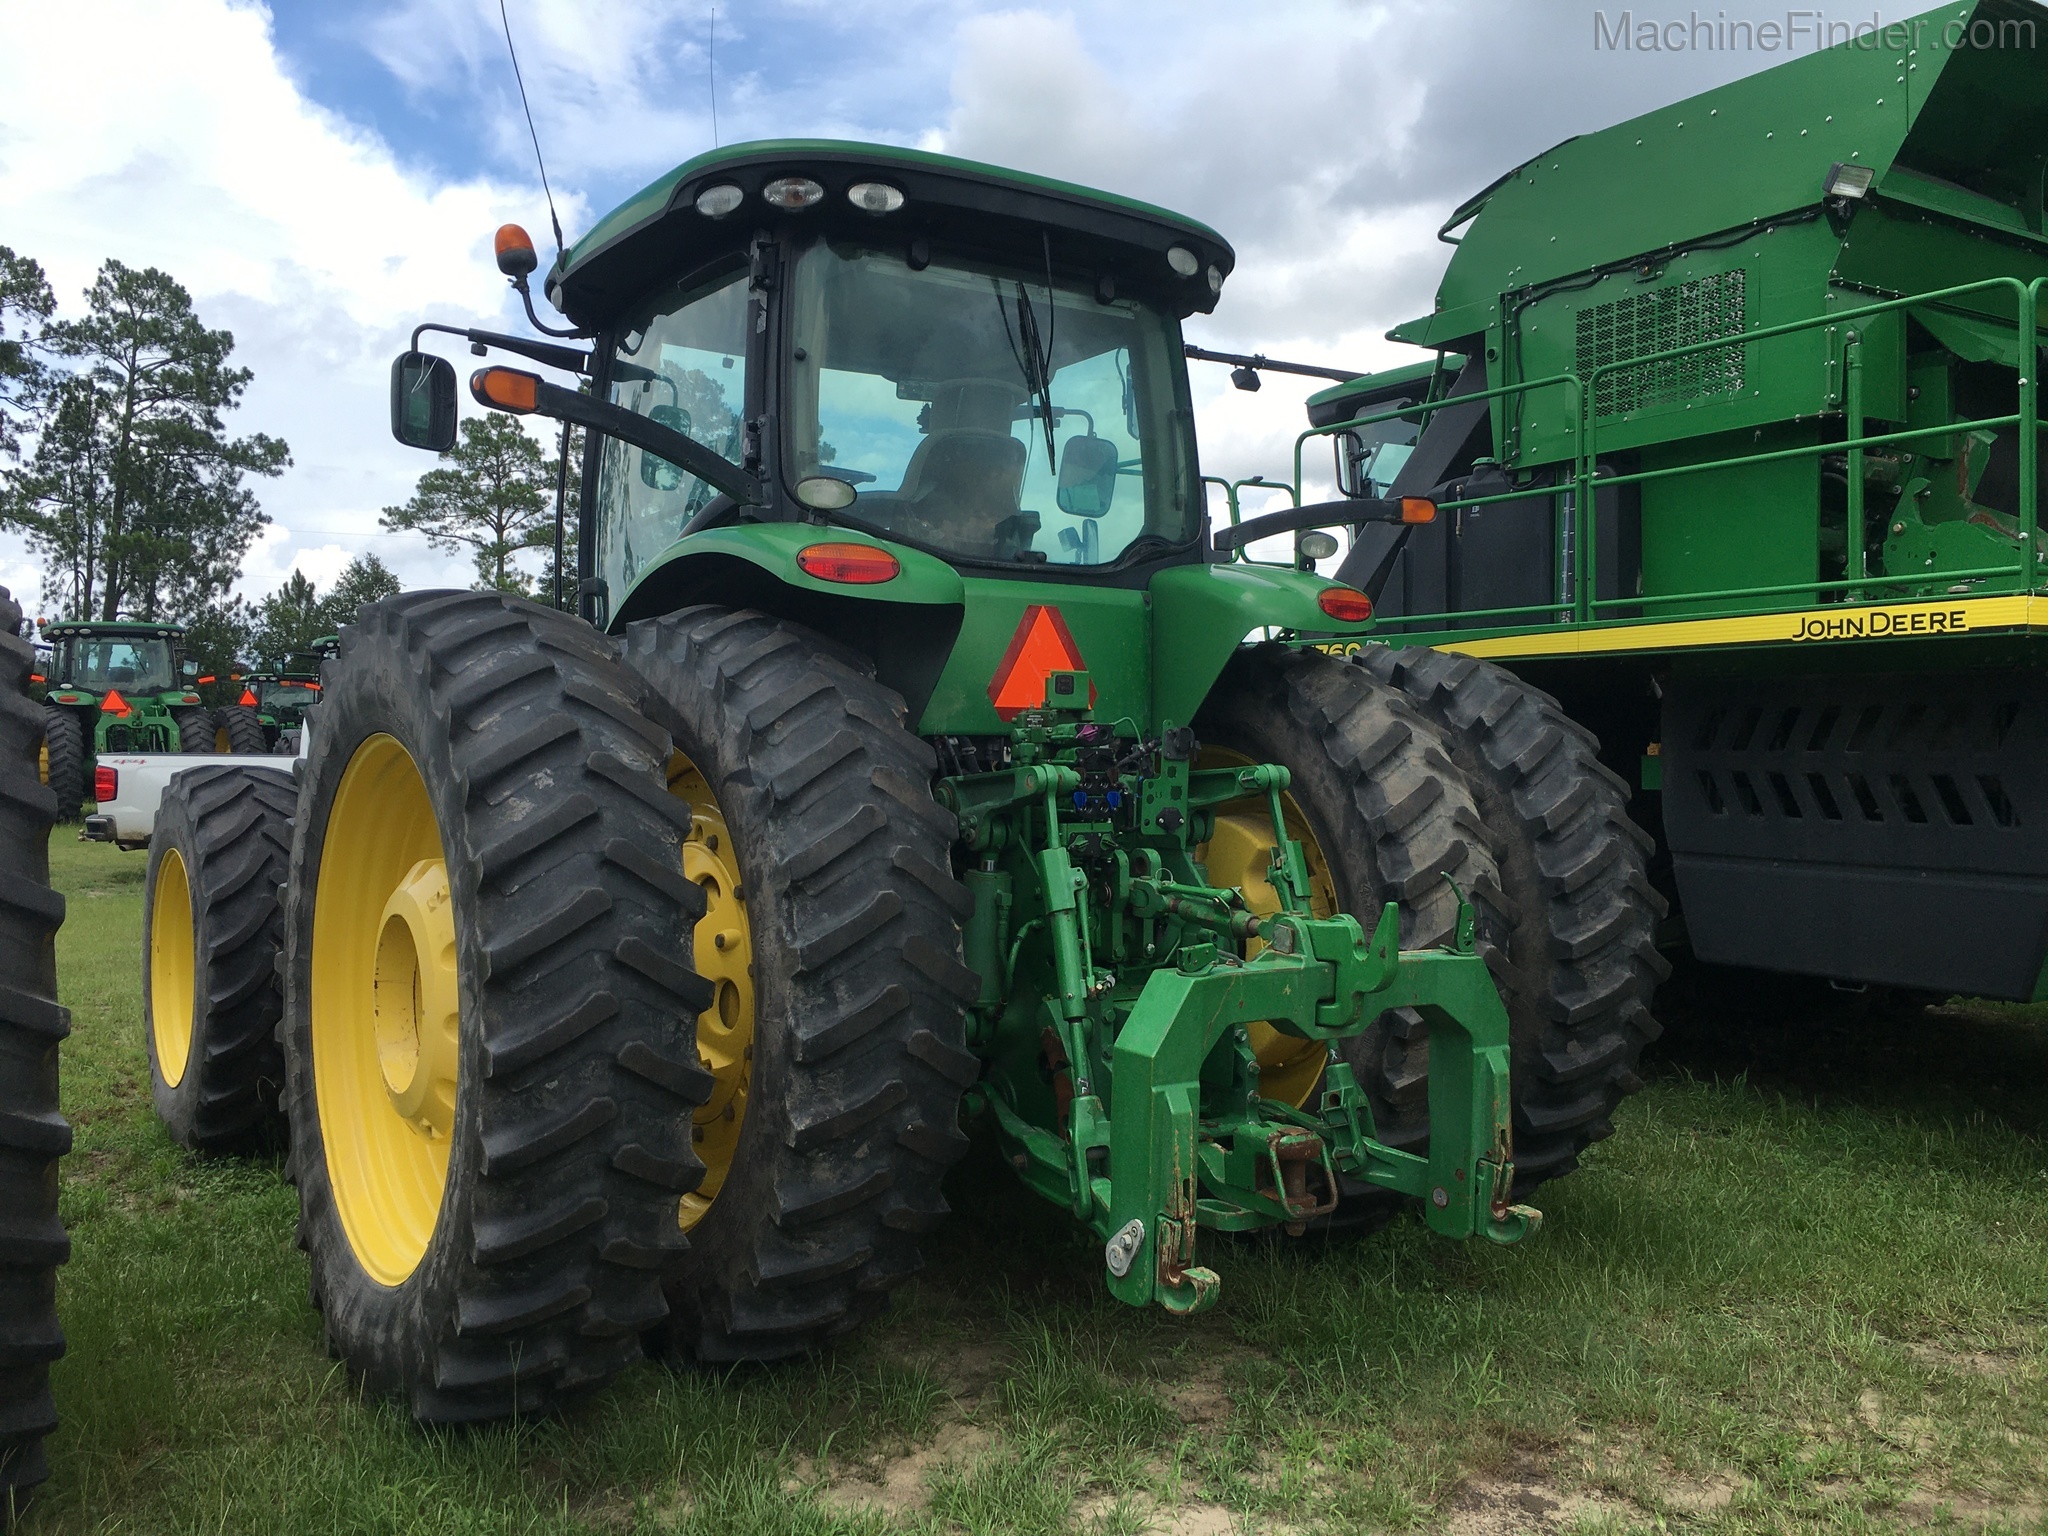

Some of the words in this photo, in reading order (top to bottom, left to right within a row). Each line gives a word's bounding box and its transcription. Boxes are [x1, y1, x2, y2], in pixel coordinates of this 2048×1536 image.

[1792, 616, 1864, 640] JOHN
[1869, 610, 1967, 635] DEERE
[1311, 642, 1362, 656] 760
